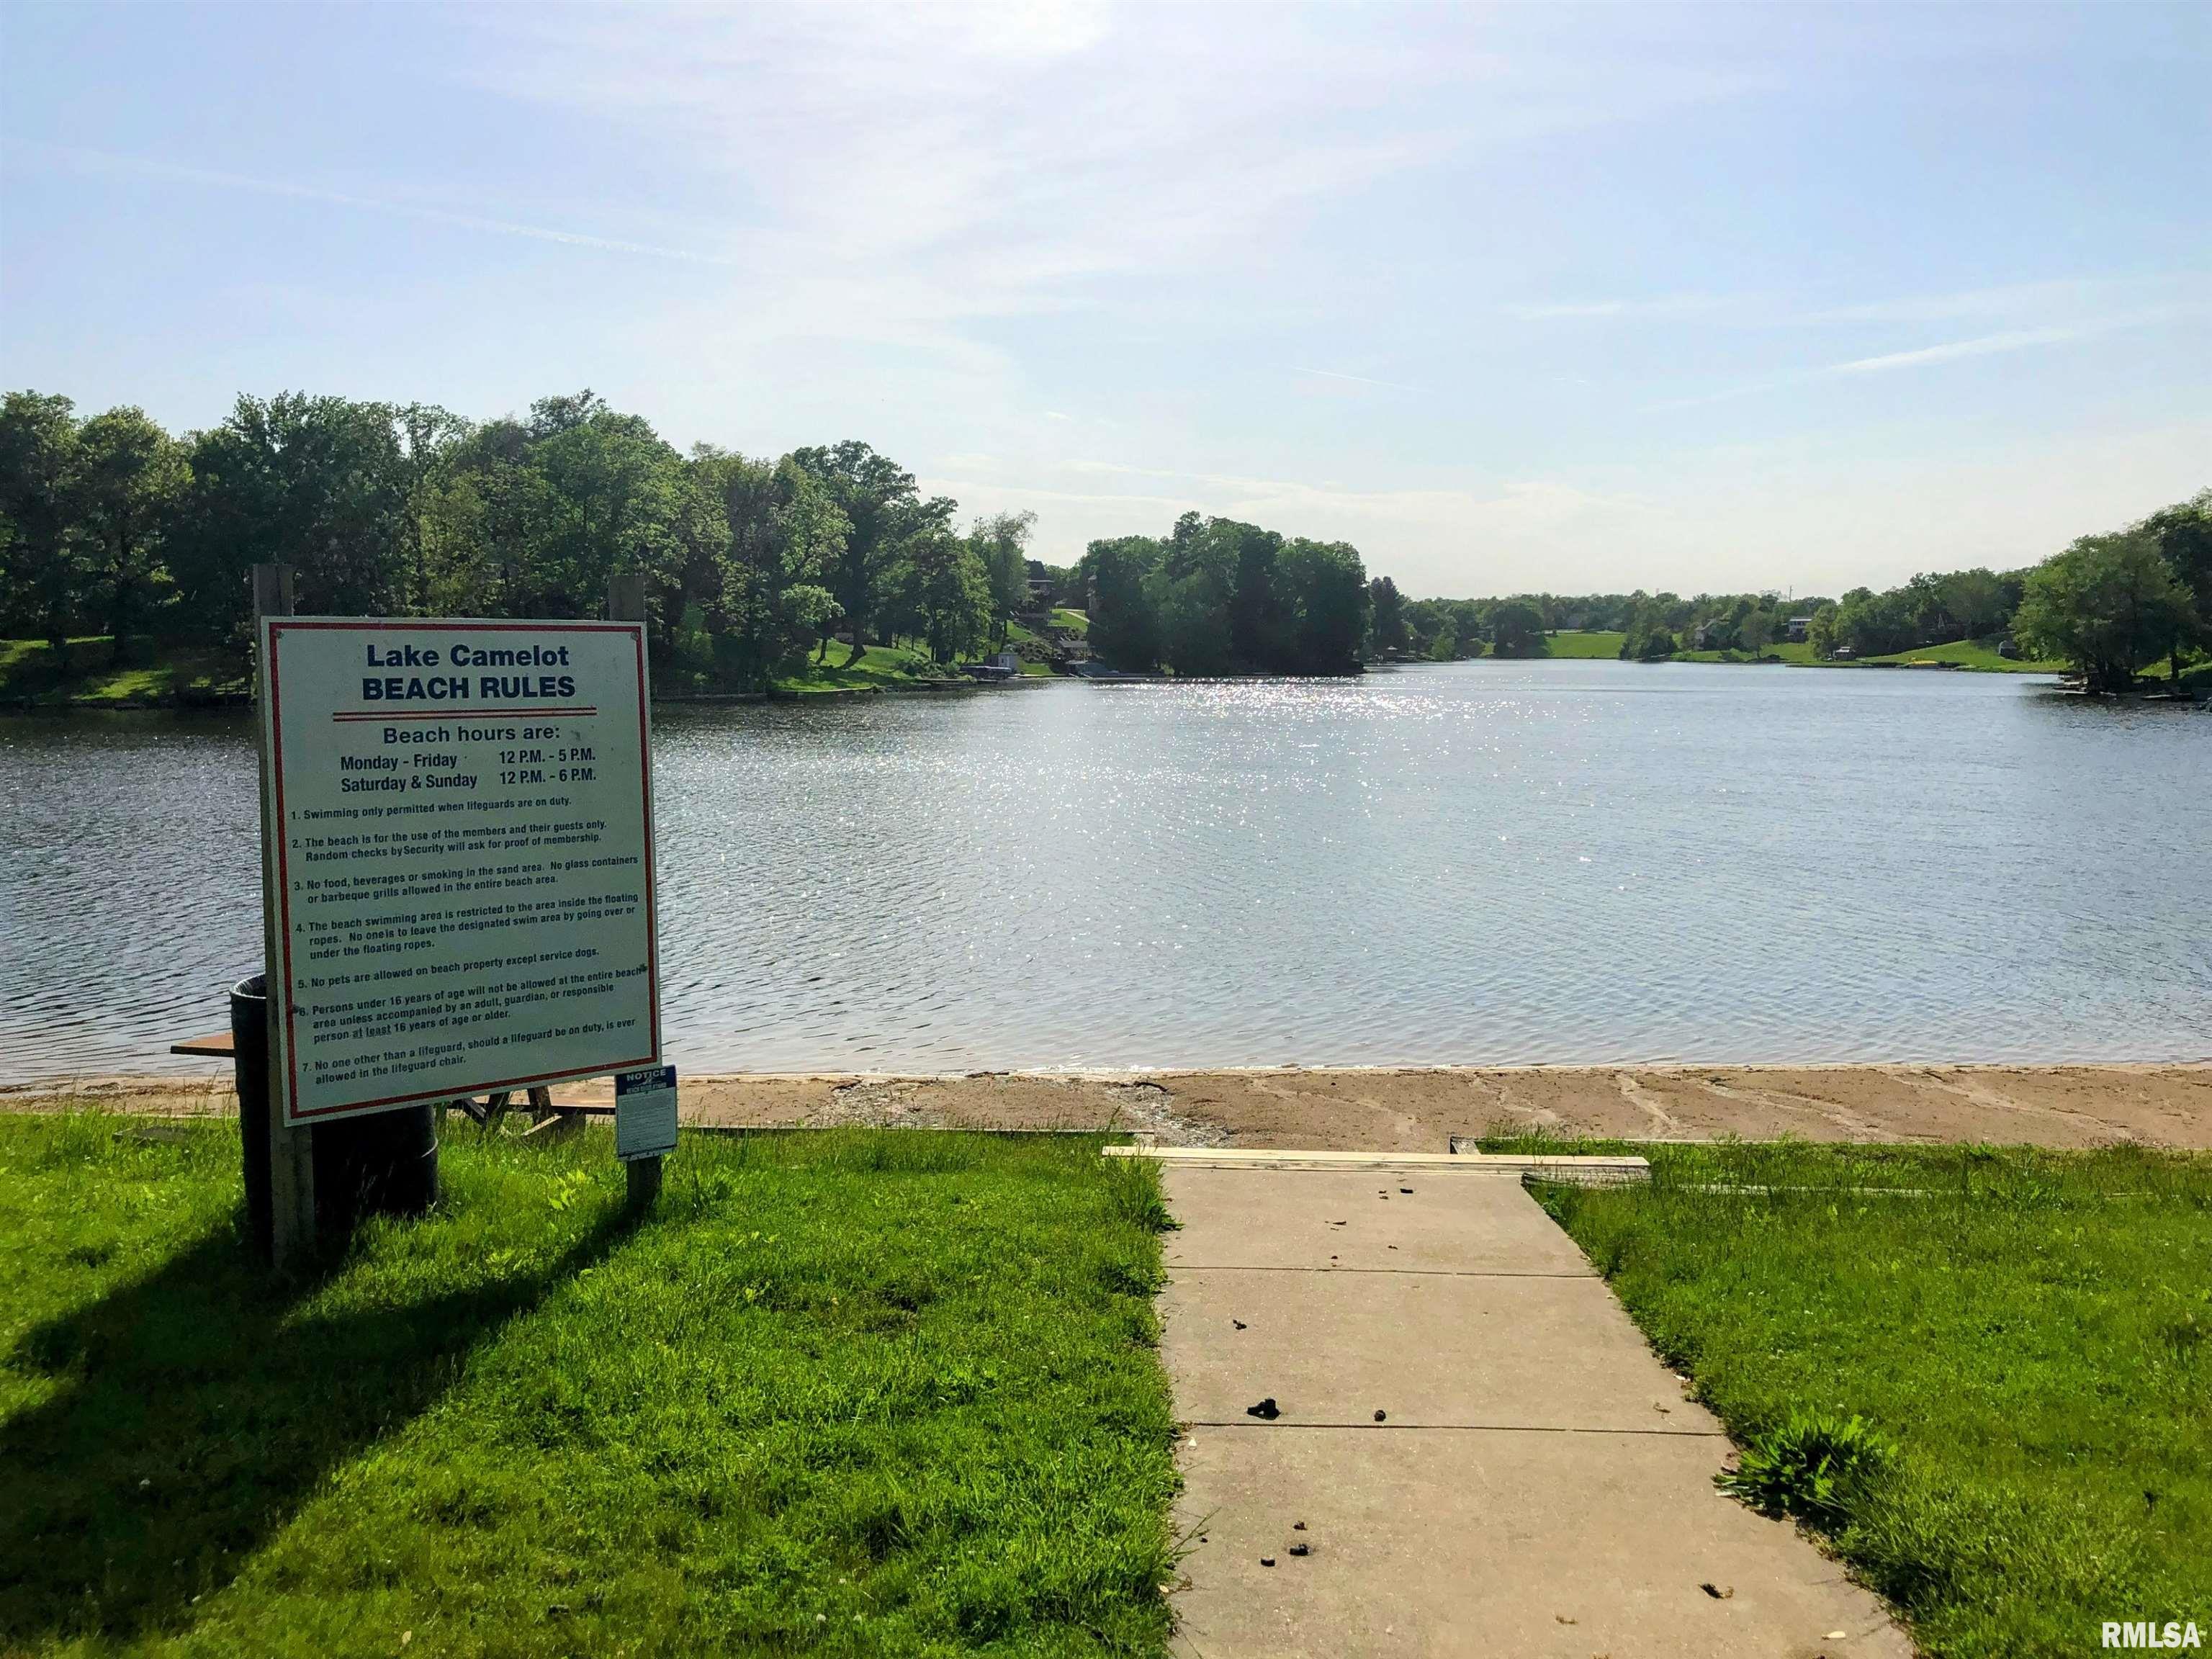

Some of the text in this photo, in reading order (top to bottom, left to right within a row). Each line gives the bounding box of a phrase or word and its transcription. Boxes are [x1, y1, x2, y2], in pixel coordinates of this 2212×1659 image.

[367, 644, 570, 667] Lake Camelot
[362, 675, 576, 701] BEACH RULES
[383, 726, 560, 744] Beach hours are:
[341, 747, 596, 771] Monday Friday 12 P.M. 5 P.M.
[341, 768, 596, 793] Saturday & Sunday 12 P.M. 6 P.M.
[303, 796, 572, 819] Swimming only permitted when lifeguards are duty.
[305, 819, 606, 848] The beach for the use of the members and their guests only.
[305, 832, 601, 862] Random checks by Security will ask for proof of membership.
[307, 880, 320, 890] No
[323, 877, 351, 889] food,
[353, 874, 405, 886] beverages
[421, 869, 463, 881] smoking
[466, 868, 475, 877] in
[478, 866, 493, 876] the
[496, 863, 519, 875] sand
[550, 861, 562, 871] No
[565, 859, 589, 871] glass
[591, 855, 639, 867] containers
[321, 891, 370, 903] barbeque
[373, 887, 399, 900] grills
[402, 884, 441, 896] allowed
[444, 883, 453, 892] in
[456, 881, 471, 891] the
[474, 878, 503, 890] entire
[505, 876, 533, 887] beach
[308, 893, 639, 932] The beach swimming area restricted to the area inside the floating
[309, 935, 342, 947] ropes.
[349, 932, 363, 942] No
[397, 927, 408, 938] to
[410, 926, 437, 936] leave
[439, 923, 456, 933] the
[458, 917, 511, 931] designated
[513, 915, 538, 926] swim
[541, 914, 561, 923] area
[563, 912, 575, 922] by
[577, 909, 602, 921] going
[604, 907, 624, 917] over
[310, 940, 435, 960] under the floating ropes.
[311, 948, 600, 988] No pets are allowed on beach property except service dogs.
[313, 966, 642, 1015] Persons under 16 years of age will not be allowed the entire beach
[313, 983, 614, 1029] area unless accompanied by adult, guardian, responsible
[313, 1010, 511, 1045] person least 16 years of age older.
[315, 1019, 636, 1071] No one other than lifeguard, should lifeguard be duty, ever
[315, 1055, 466, 1085] allowed in the lifeguard chair.
[626, 1069, 667, 1082] NOTICE
